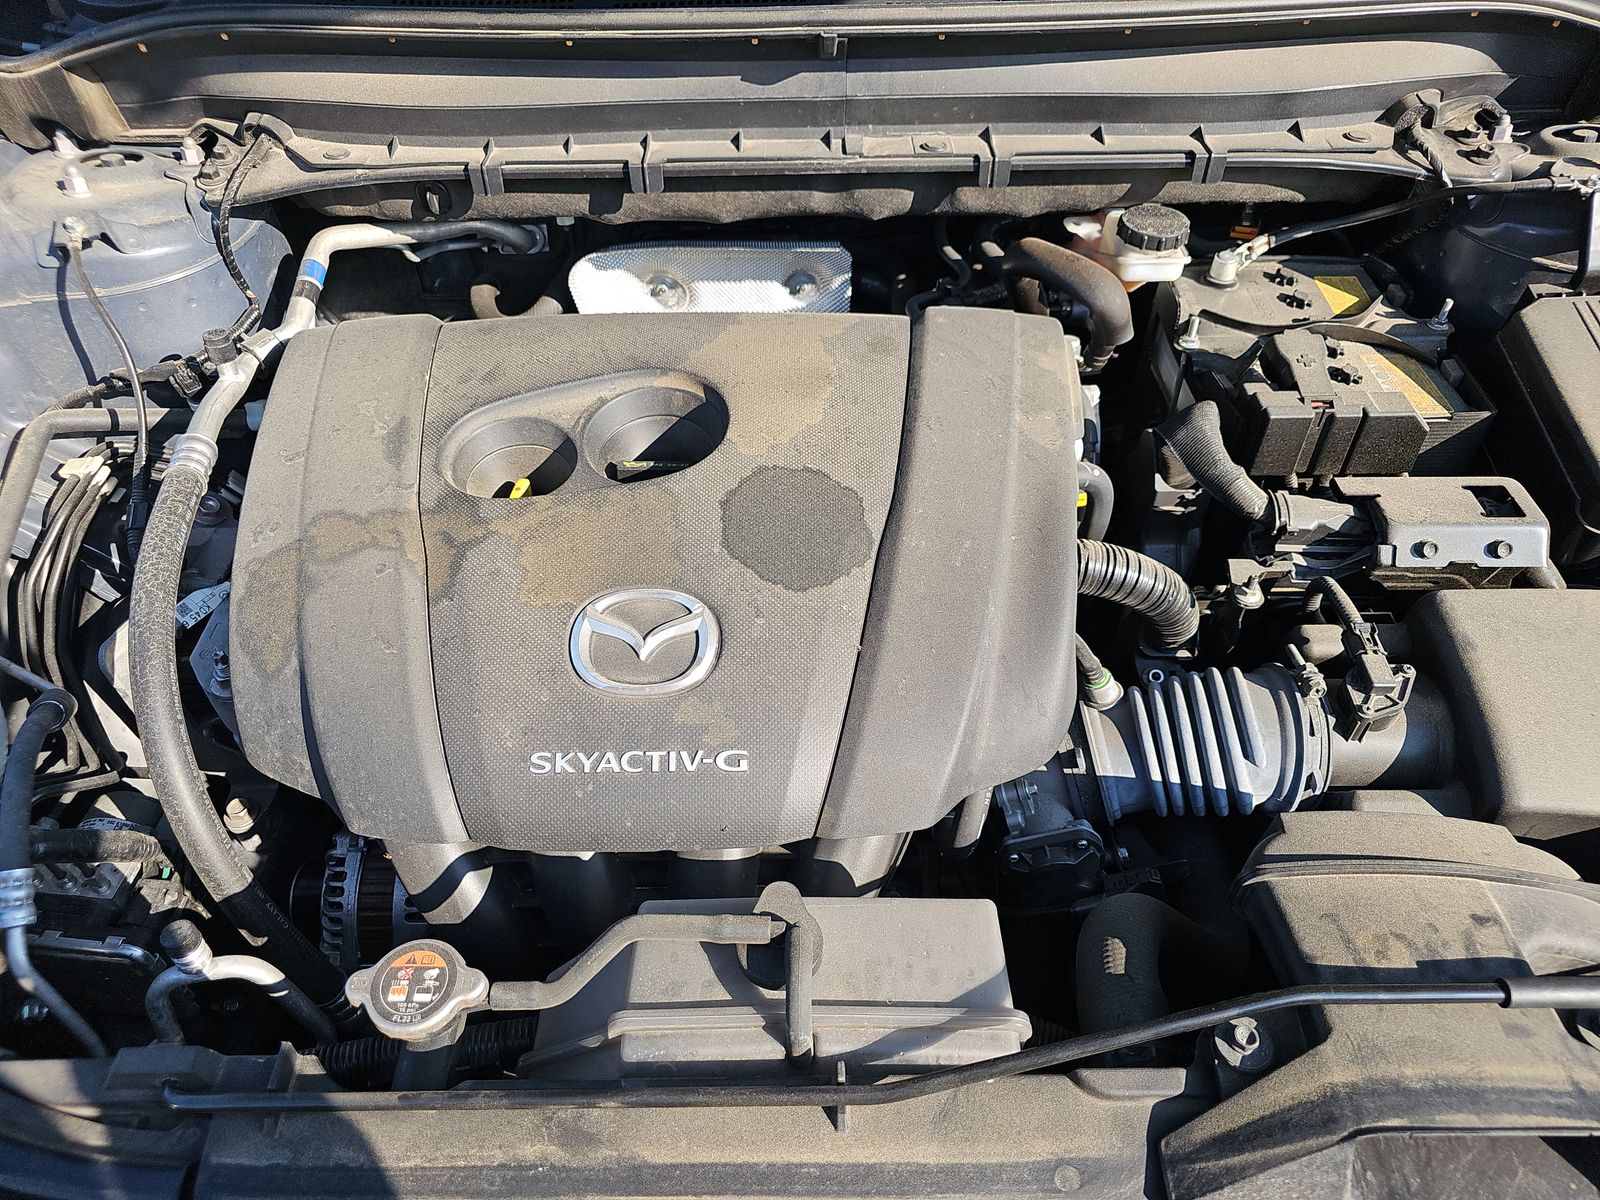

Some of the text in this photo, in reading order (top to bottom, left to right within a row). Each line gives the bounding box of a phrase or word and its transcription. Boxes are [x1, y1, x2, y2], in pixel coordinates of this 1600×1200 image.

[189, 603, 212, 622] KD45
[178, 722, 188, 742] HOSE
[184, 744, 198, 776] SUCTION
[529, 750, 748, 774] SKYACTIV-G
[265, 901, 289, 928] GALAXY
[392, 1014, 411, 1023] FL22
